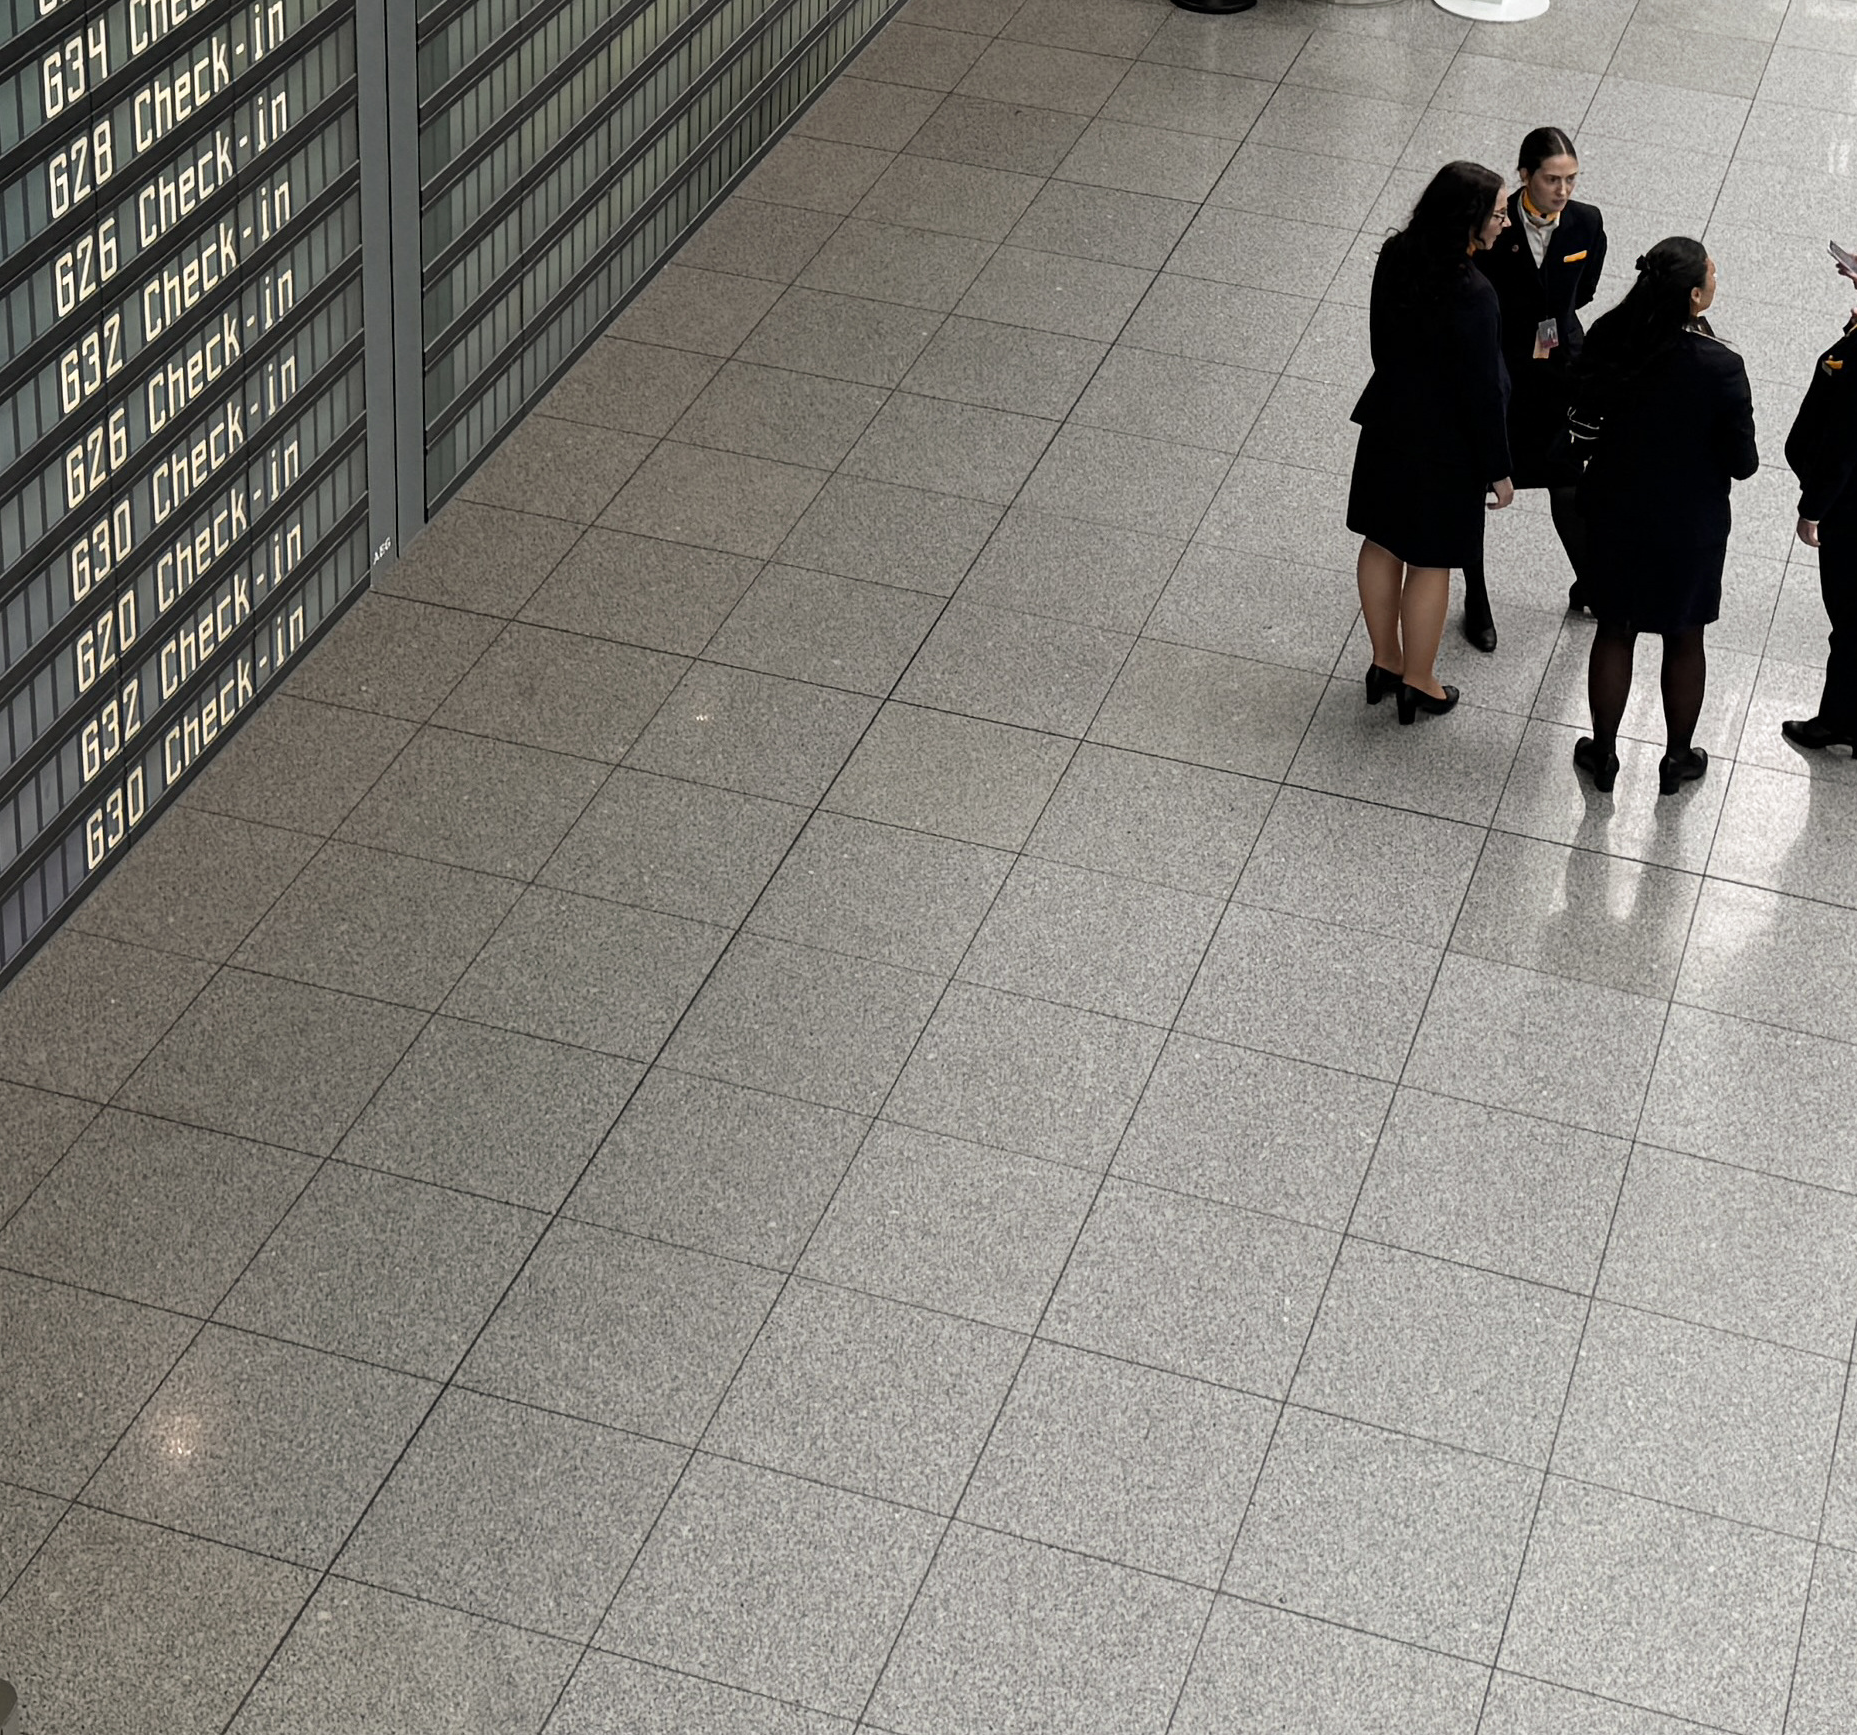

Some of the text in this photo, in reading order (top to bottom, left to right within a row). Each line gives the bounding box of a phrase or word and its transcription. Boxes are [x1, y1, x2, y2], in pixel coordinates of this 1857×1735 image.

[43, 18, 107, 118] G34
[49, 120, 112, 218] G28
[134, 0, 283, 152] Check-in
